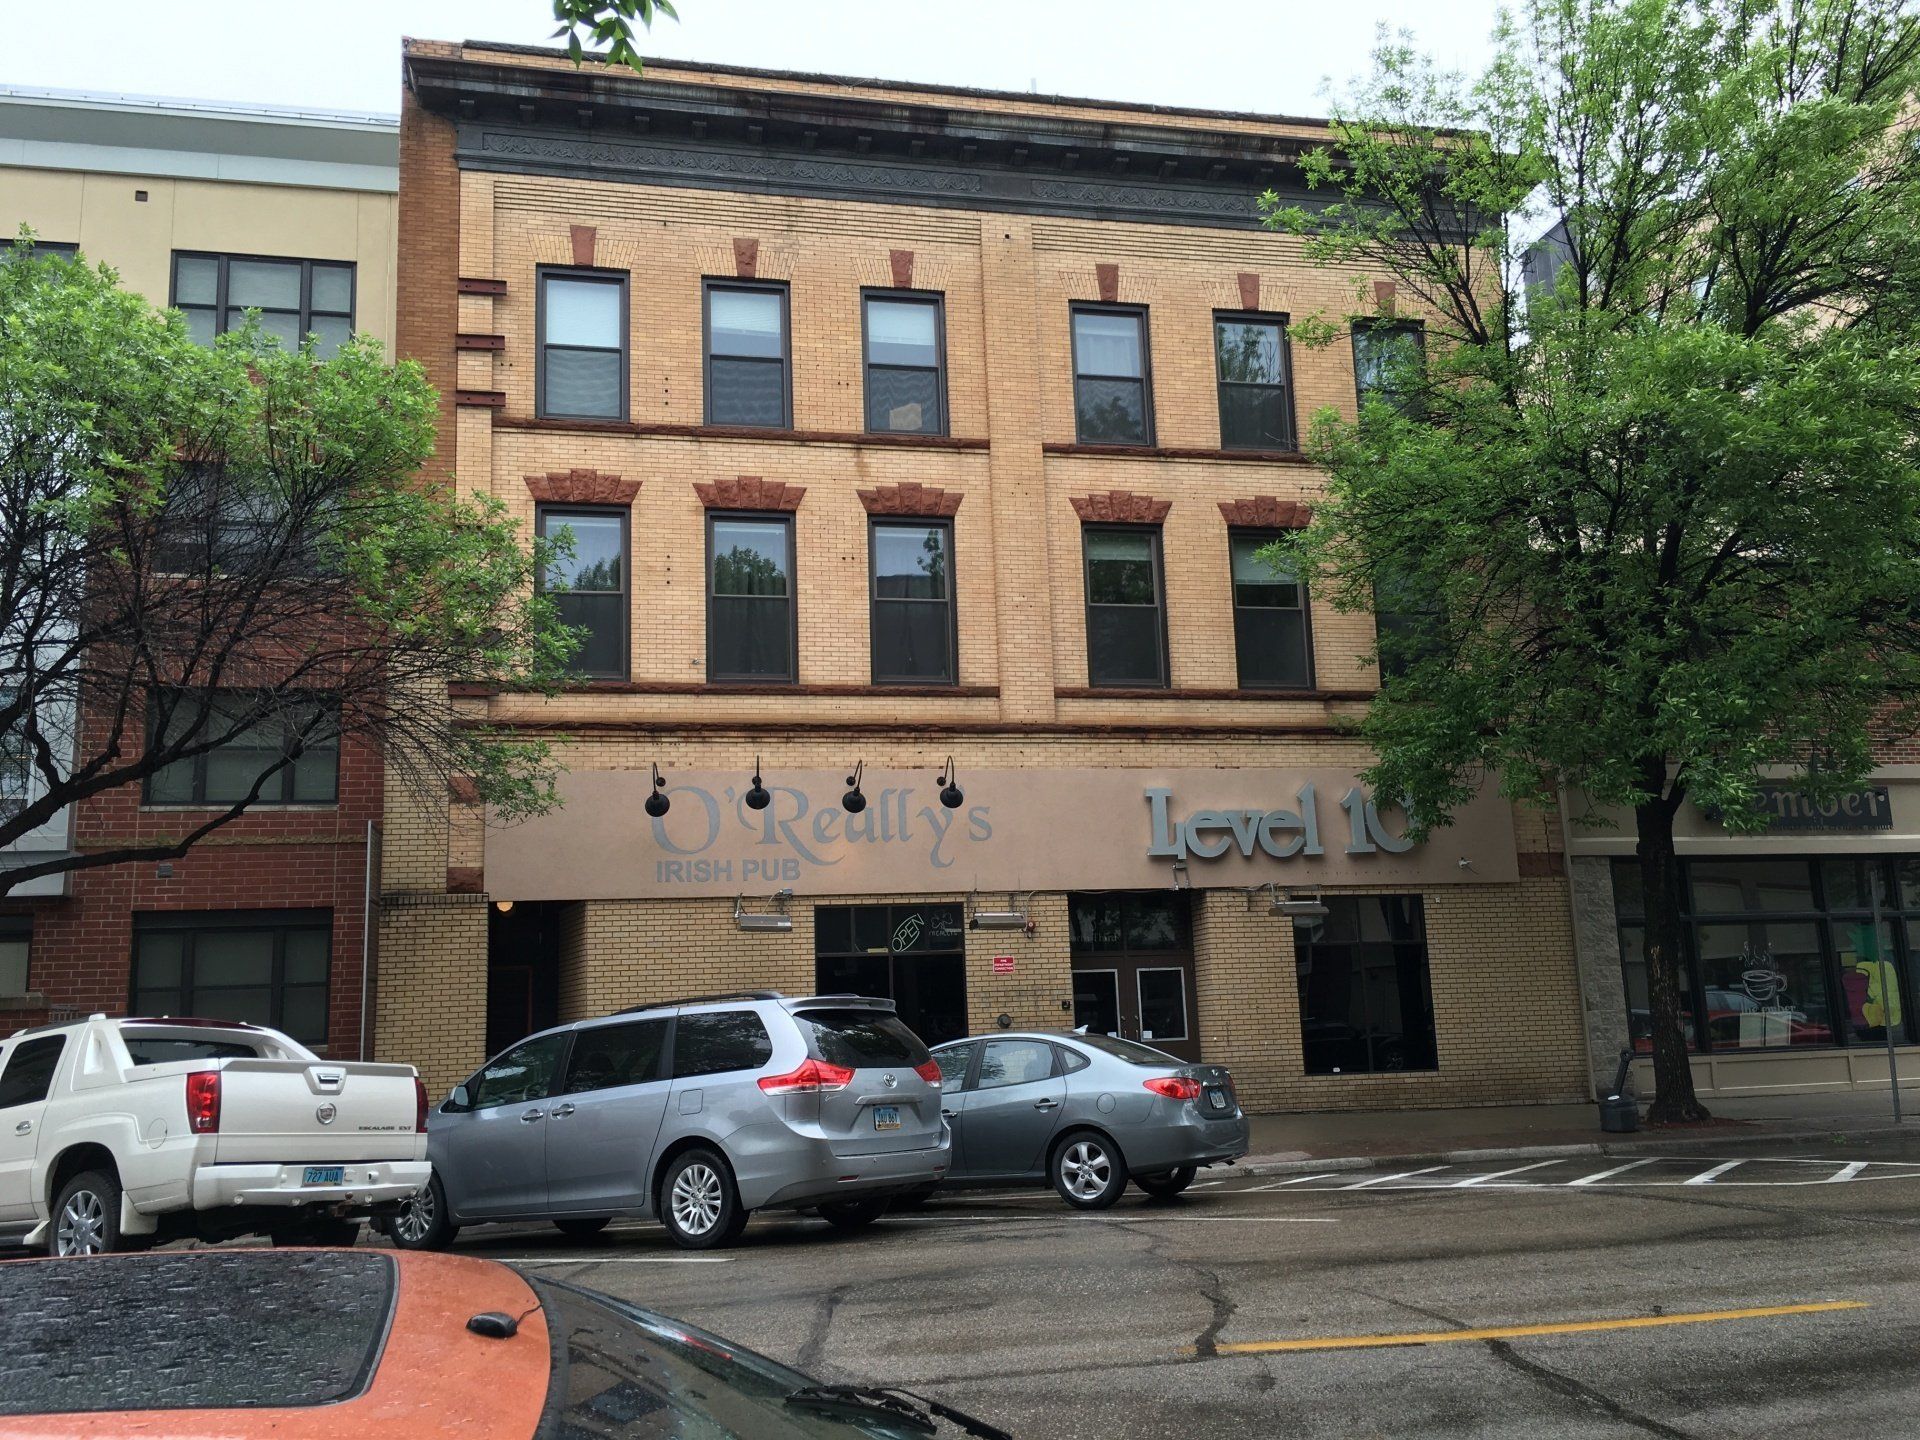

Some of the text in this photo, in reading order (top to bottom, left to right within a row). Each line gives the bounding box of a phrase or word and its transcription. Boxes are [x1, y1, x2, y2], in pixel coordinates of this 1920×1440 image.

[1145, 779, 1324, 860] Level
[656, 858, 802, 883] IRISH PUB
[891, 913, 925, 952] OPEN
[307, 1171, 322, 1183] 727
